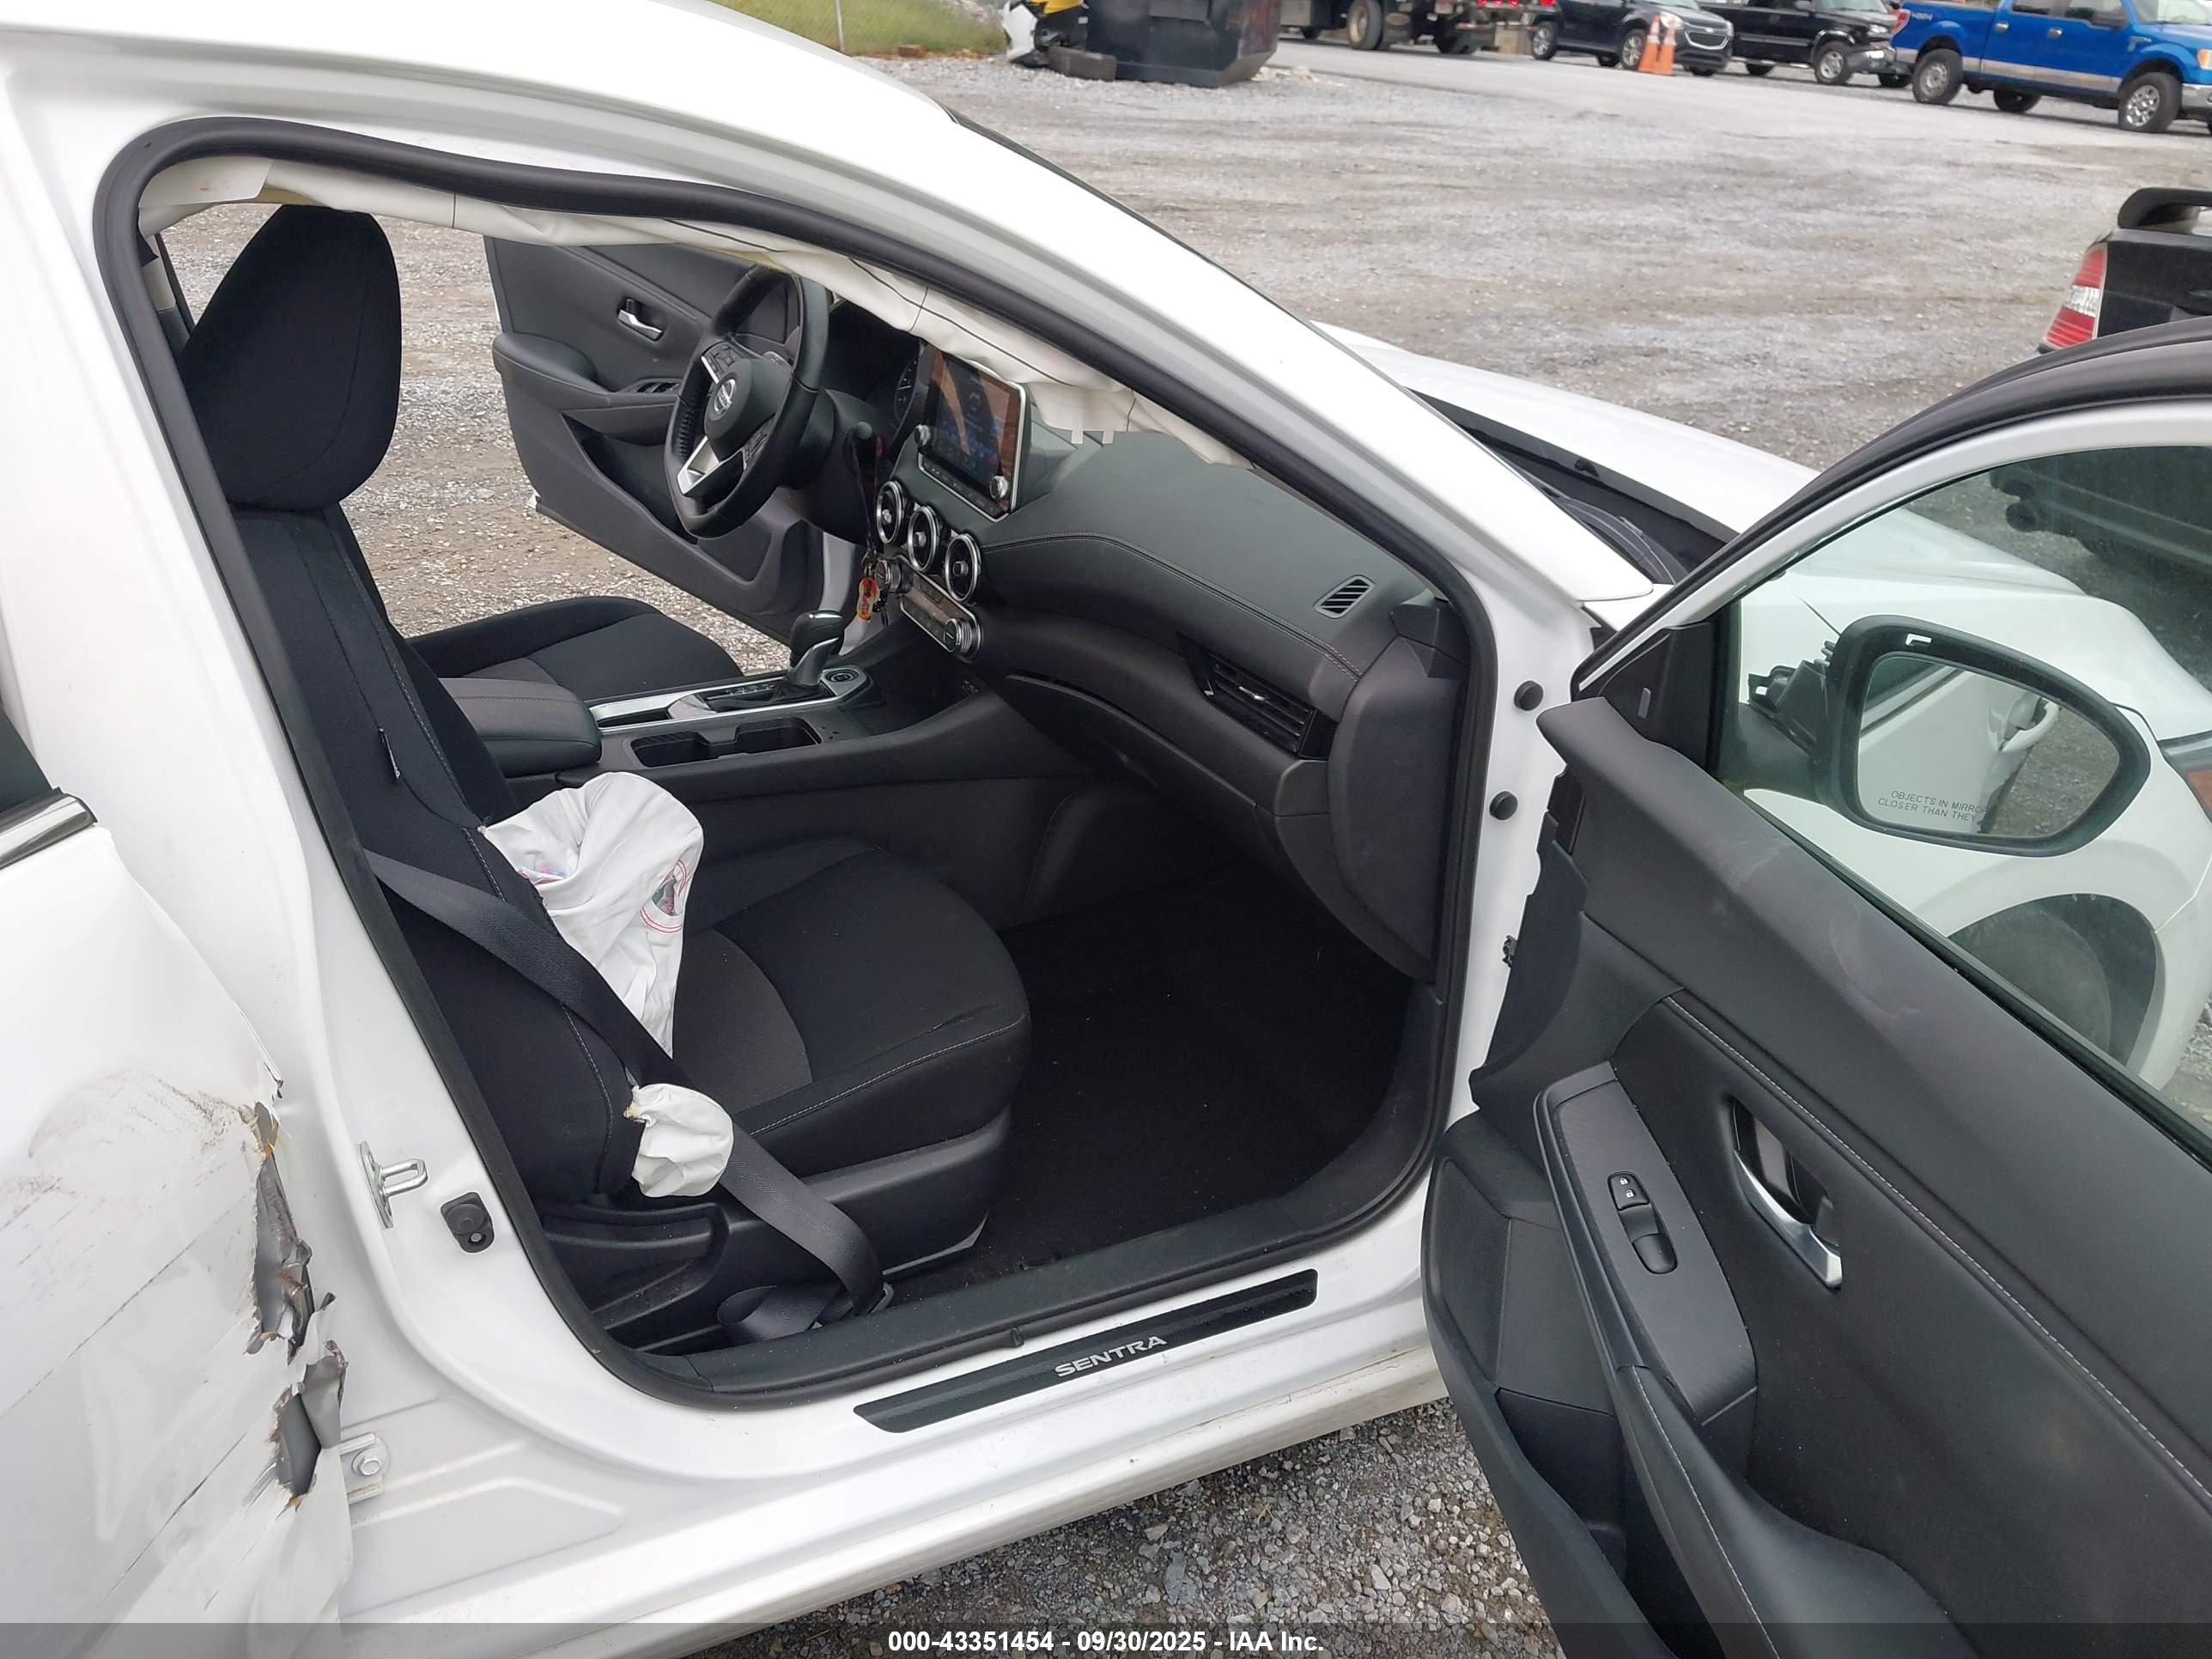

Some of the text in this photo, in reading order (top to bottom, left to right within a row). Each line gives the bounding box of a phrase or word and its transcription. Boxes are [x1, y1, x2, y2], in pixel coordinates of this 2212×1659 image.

[1878, 798, 1977, 823] CLOSER THAN THEY
[1891, 790, 1936, 805] OBJECTS
[1938, 797, 1949, 808] IN
[1054, 1335, 1168, 1377] SENTRA
